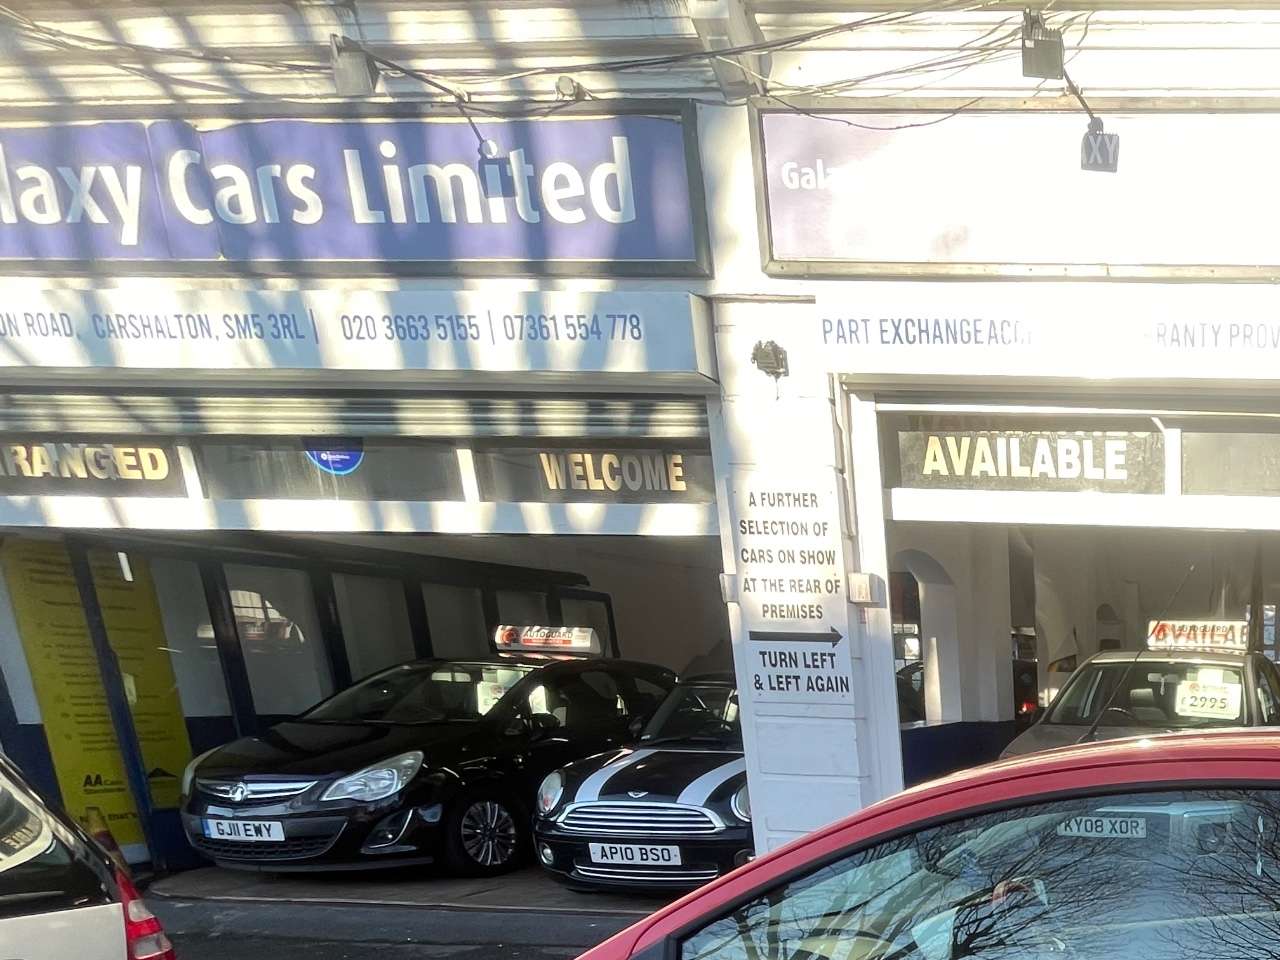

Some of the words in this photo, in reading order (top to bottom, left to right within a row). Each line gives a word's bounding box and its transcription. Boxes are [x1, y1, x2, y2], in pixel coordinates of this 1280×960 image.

[168, 150, 323, 225] Cars
[344, 136, 636, 223] Limited
[91, 313, 219, 342] CARSHALTON,
[225, 313, 264, 340] SM5
[267, 314, 305, 340] 3RL
[341, 315, 377, 340] 020
[383, 315, 430, 340] 3663
[435, 315, 480, 340] 5155
[503, 315, 560, 340] 07361
[565, 315, 602, 340] 554
[606, 315, 642, 340] 778
[822, 318, 870, 345] PART
[879, 318, 984, 345] EXCHANGE
[922, 436, 1128, 480] AVAILABLE
[539, 452, 688, 491] WELCOME
[749, 492, 757, 507] A
[761, 492, 818, 508] FURTHER
[739, 519, 808, 536] SELECTION
[813, 522, 828, 536] OF
[741, 548, 773, 564] CARS
[778, 550, 795, 564] ON
[799, 550, 836, 565] SHOW
[743, 577, 757, 593] AT
[762, 578, 784, 593] THE
[789, 578, 822, 594] REAR
[825, 579, 841, 594] OF
[762, 603, 823, 619] PREMISES
[759, 651, 798, 668] TURN
[803, 652, 836, 669] LEFT
[754, 674, 764, 691] &
[768, 675, 800, 692] LEFT
[806, 676, 850, 693] AGAIN
[242, 824, 272, 838] EWY
[1064, 818, 1104, 833] KY08
[600, 846, 634, 861] AP10
[639, 847, 671, 862] BSO
